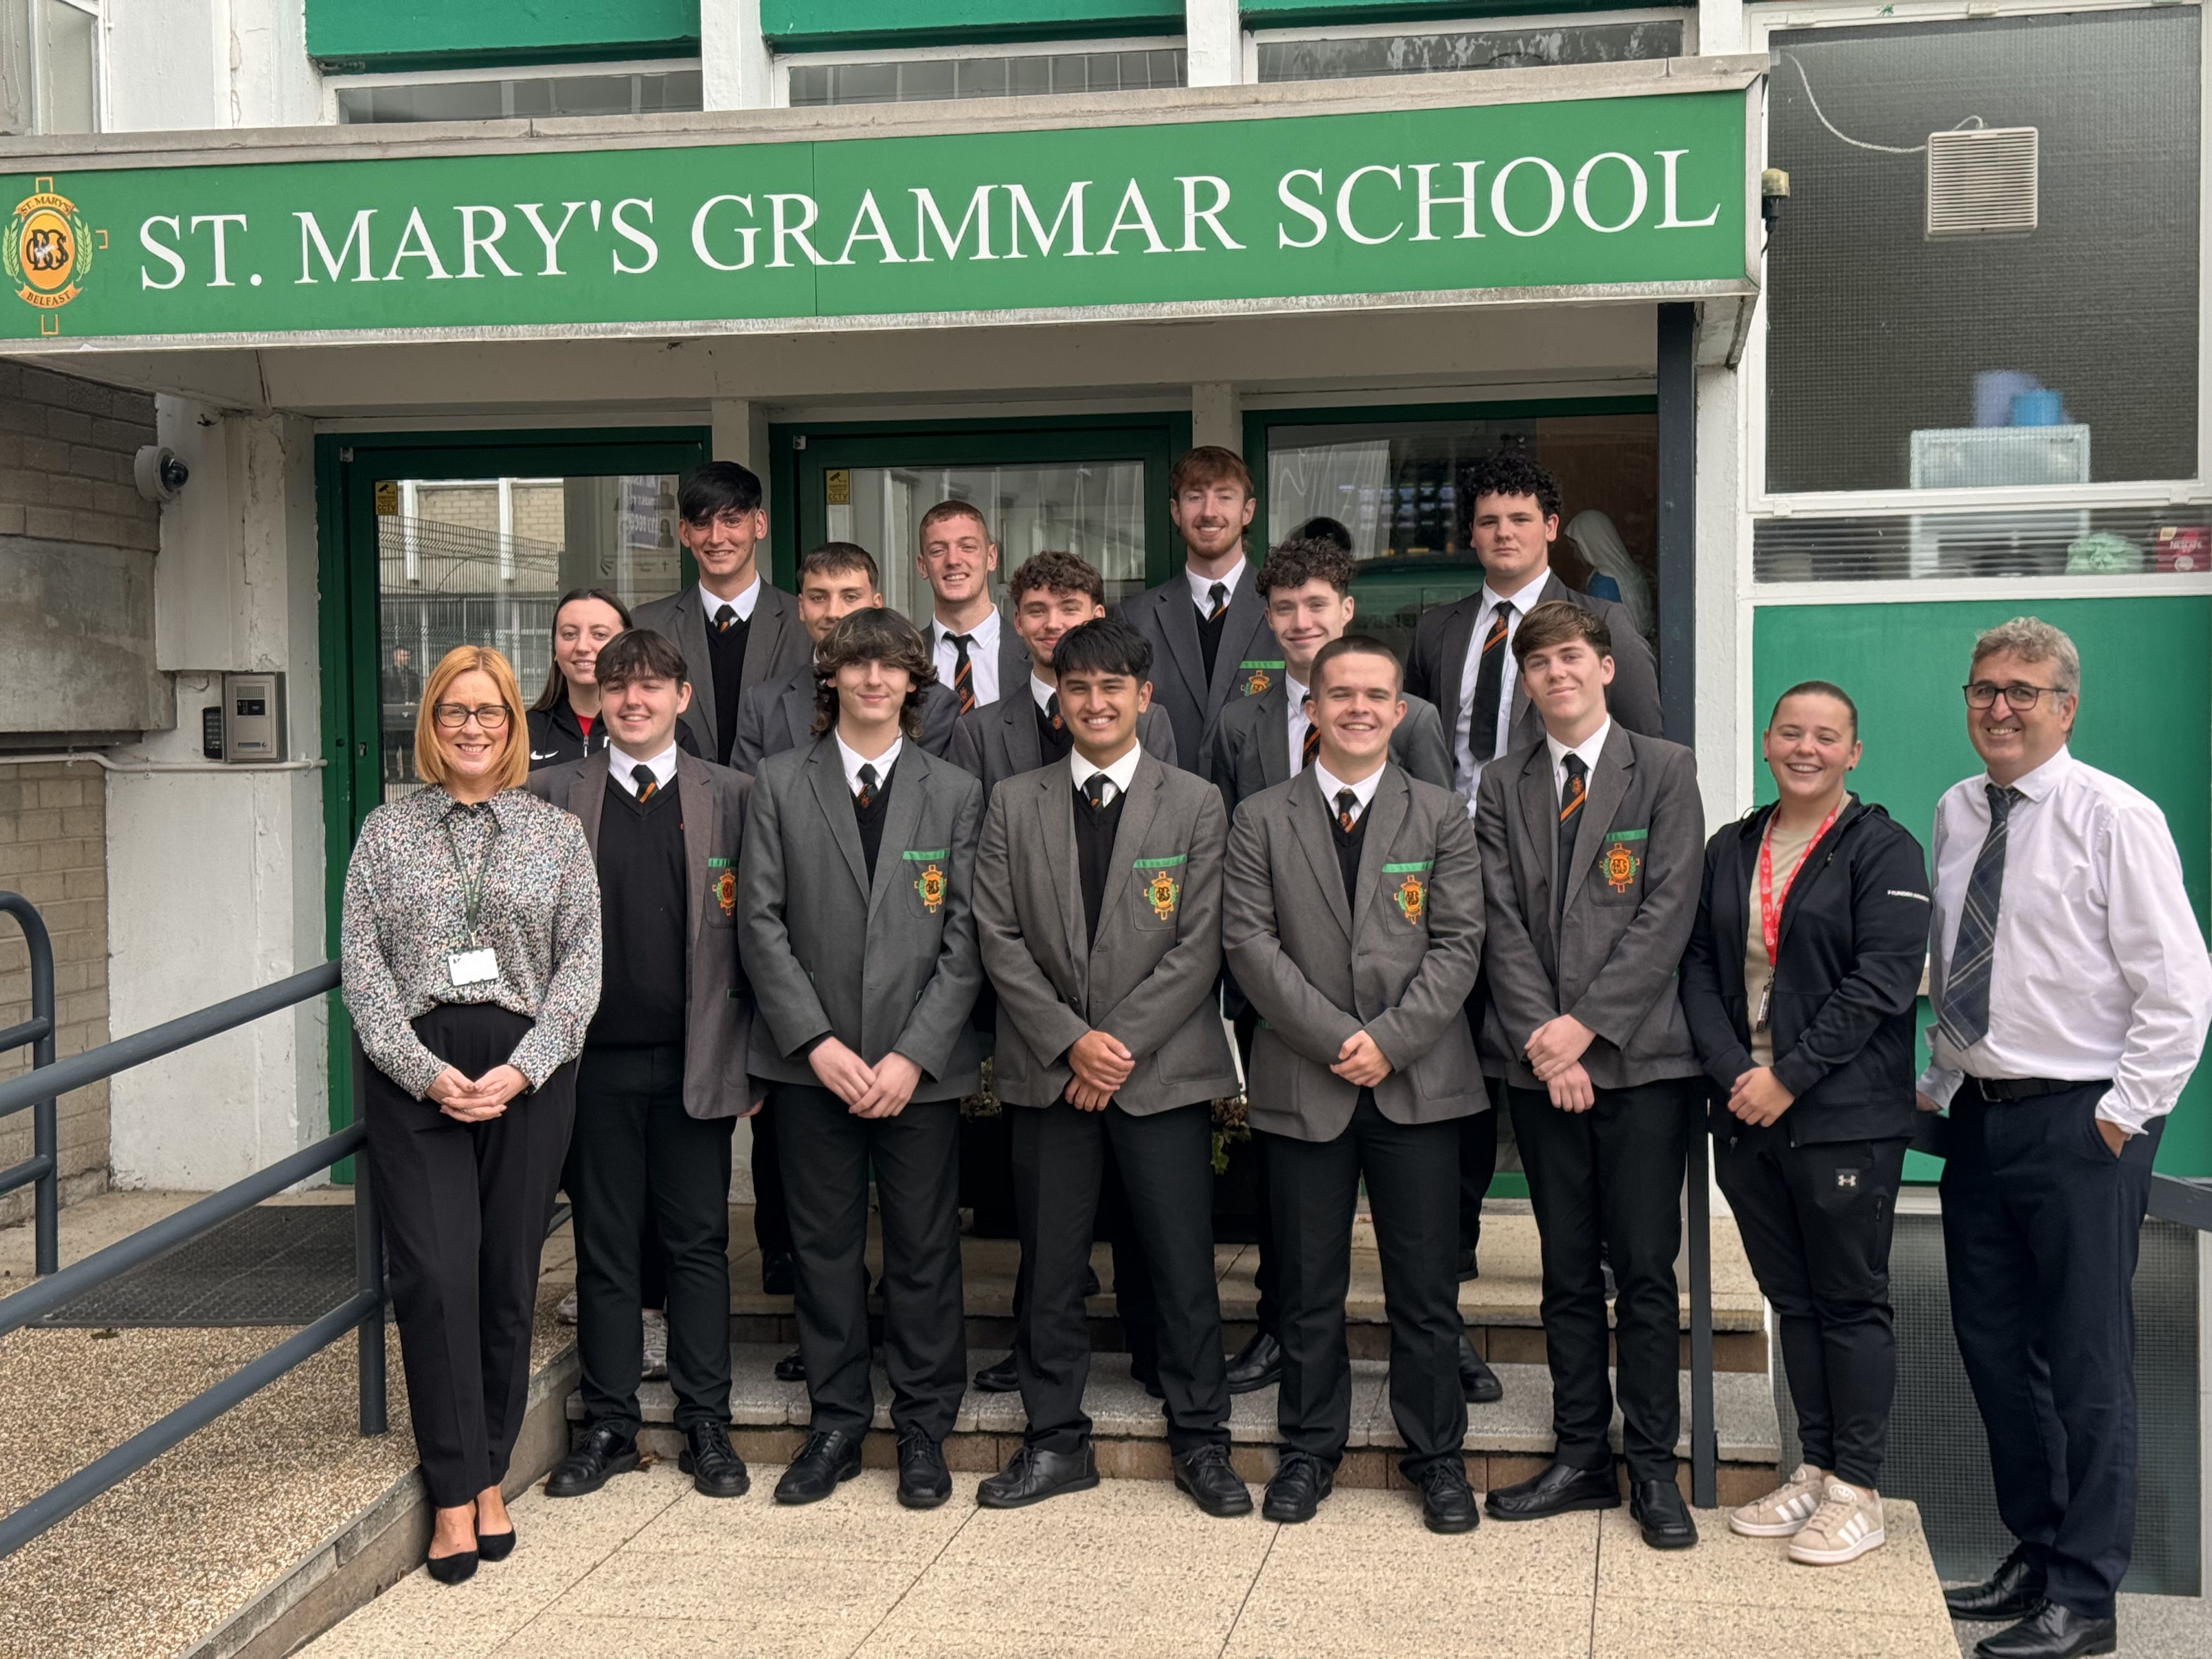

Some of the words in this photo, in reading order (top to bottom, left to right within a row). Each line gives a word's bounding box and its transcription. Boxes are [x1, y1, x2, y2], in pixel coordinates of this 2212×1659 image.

[140, 213, 263, 291] ST.
[291, 198, 659, 285] MARY'S
[691, 176, 1248, 272] GRAMMAR
[1278, 149, 1720, 250] SCHOOL
[26, 291, 71, 306] BELFAST
